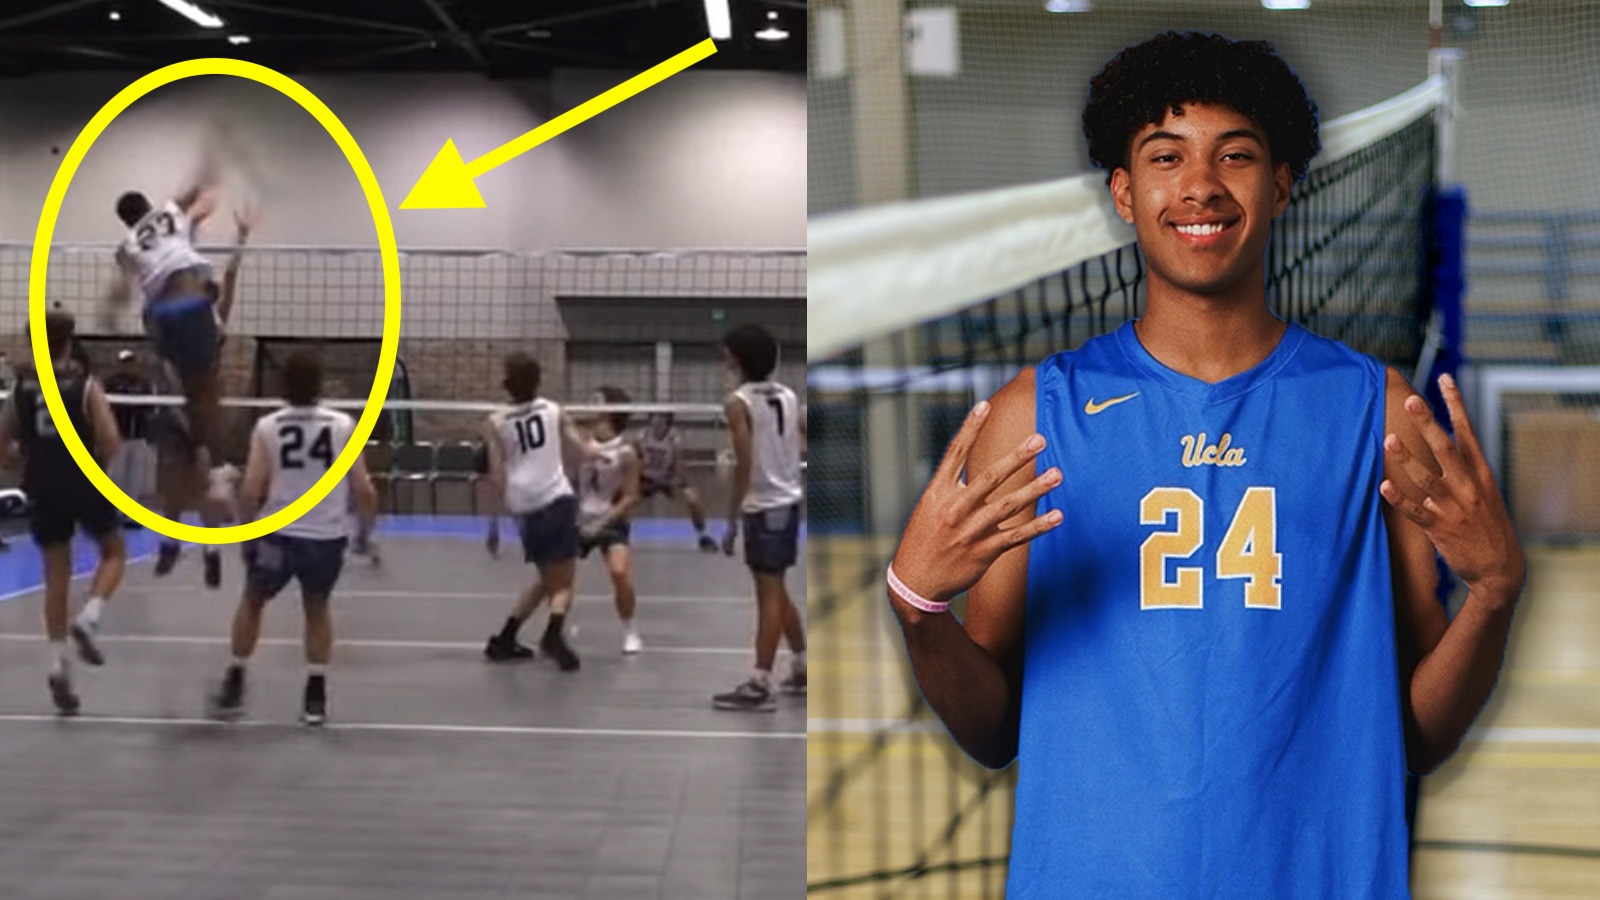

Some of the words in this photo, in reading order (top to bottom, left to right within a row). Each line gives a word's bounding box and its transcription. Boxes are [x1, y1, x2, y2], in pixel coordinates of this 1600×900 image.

[278, 425, 334, 469] 24
[515, 414, 546, 454] 10
[1181, 432, 1247, 468] Ucla
[1139, 486, 1283, 611] 24
